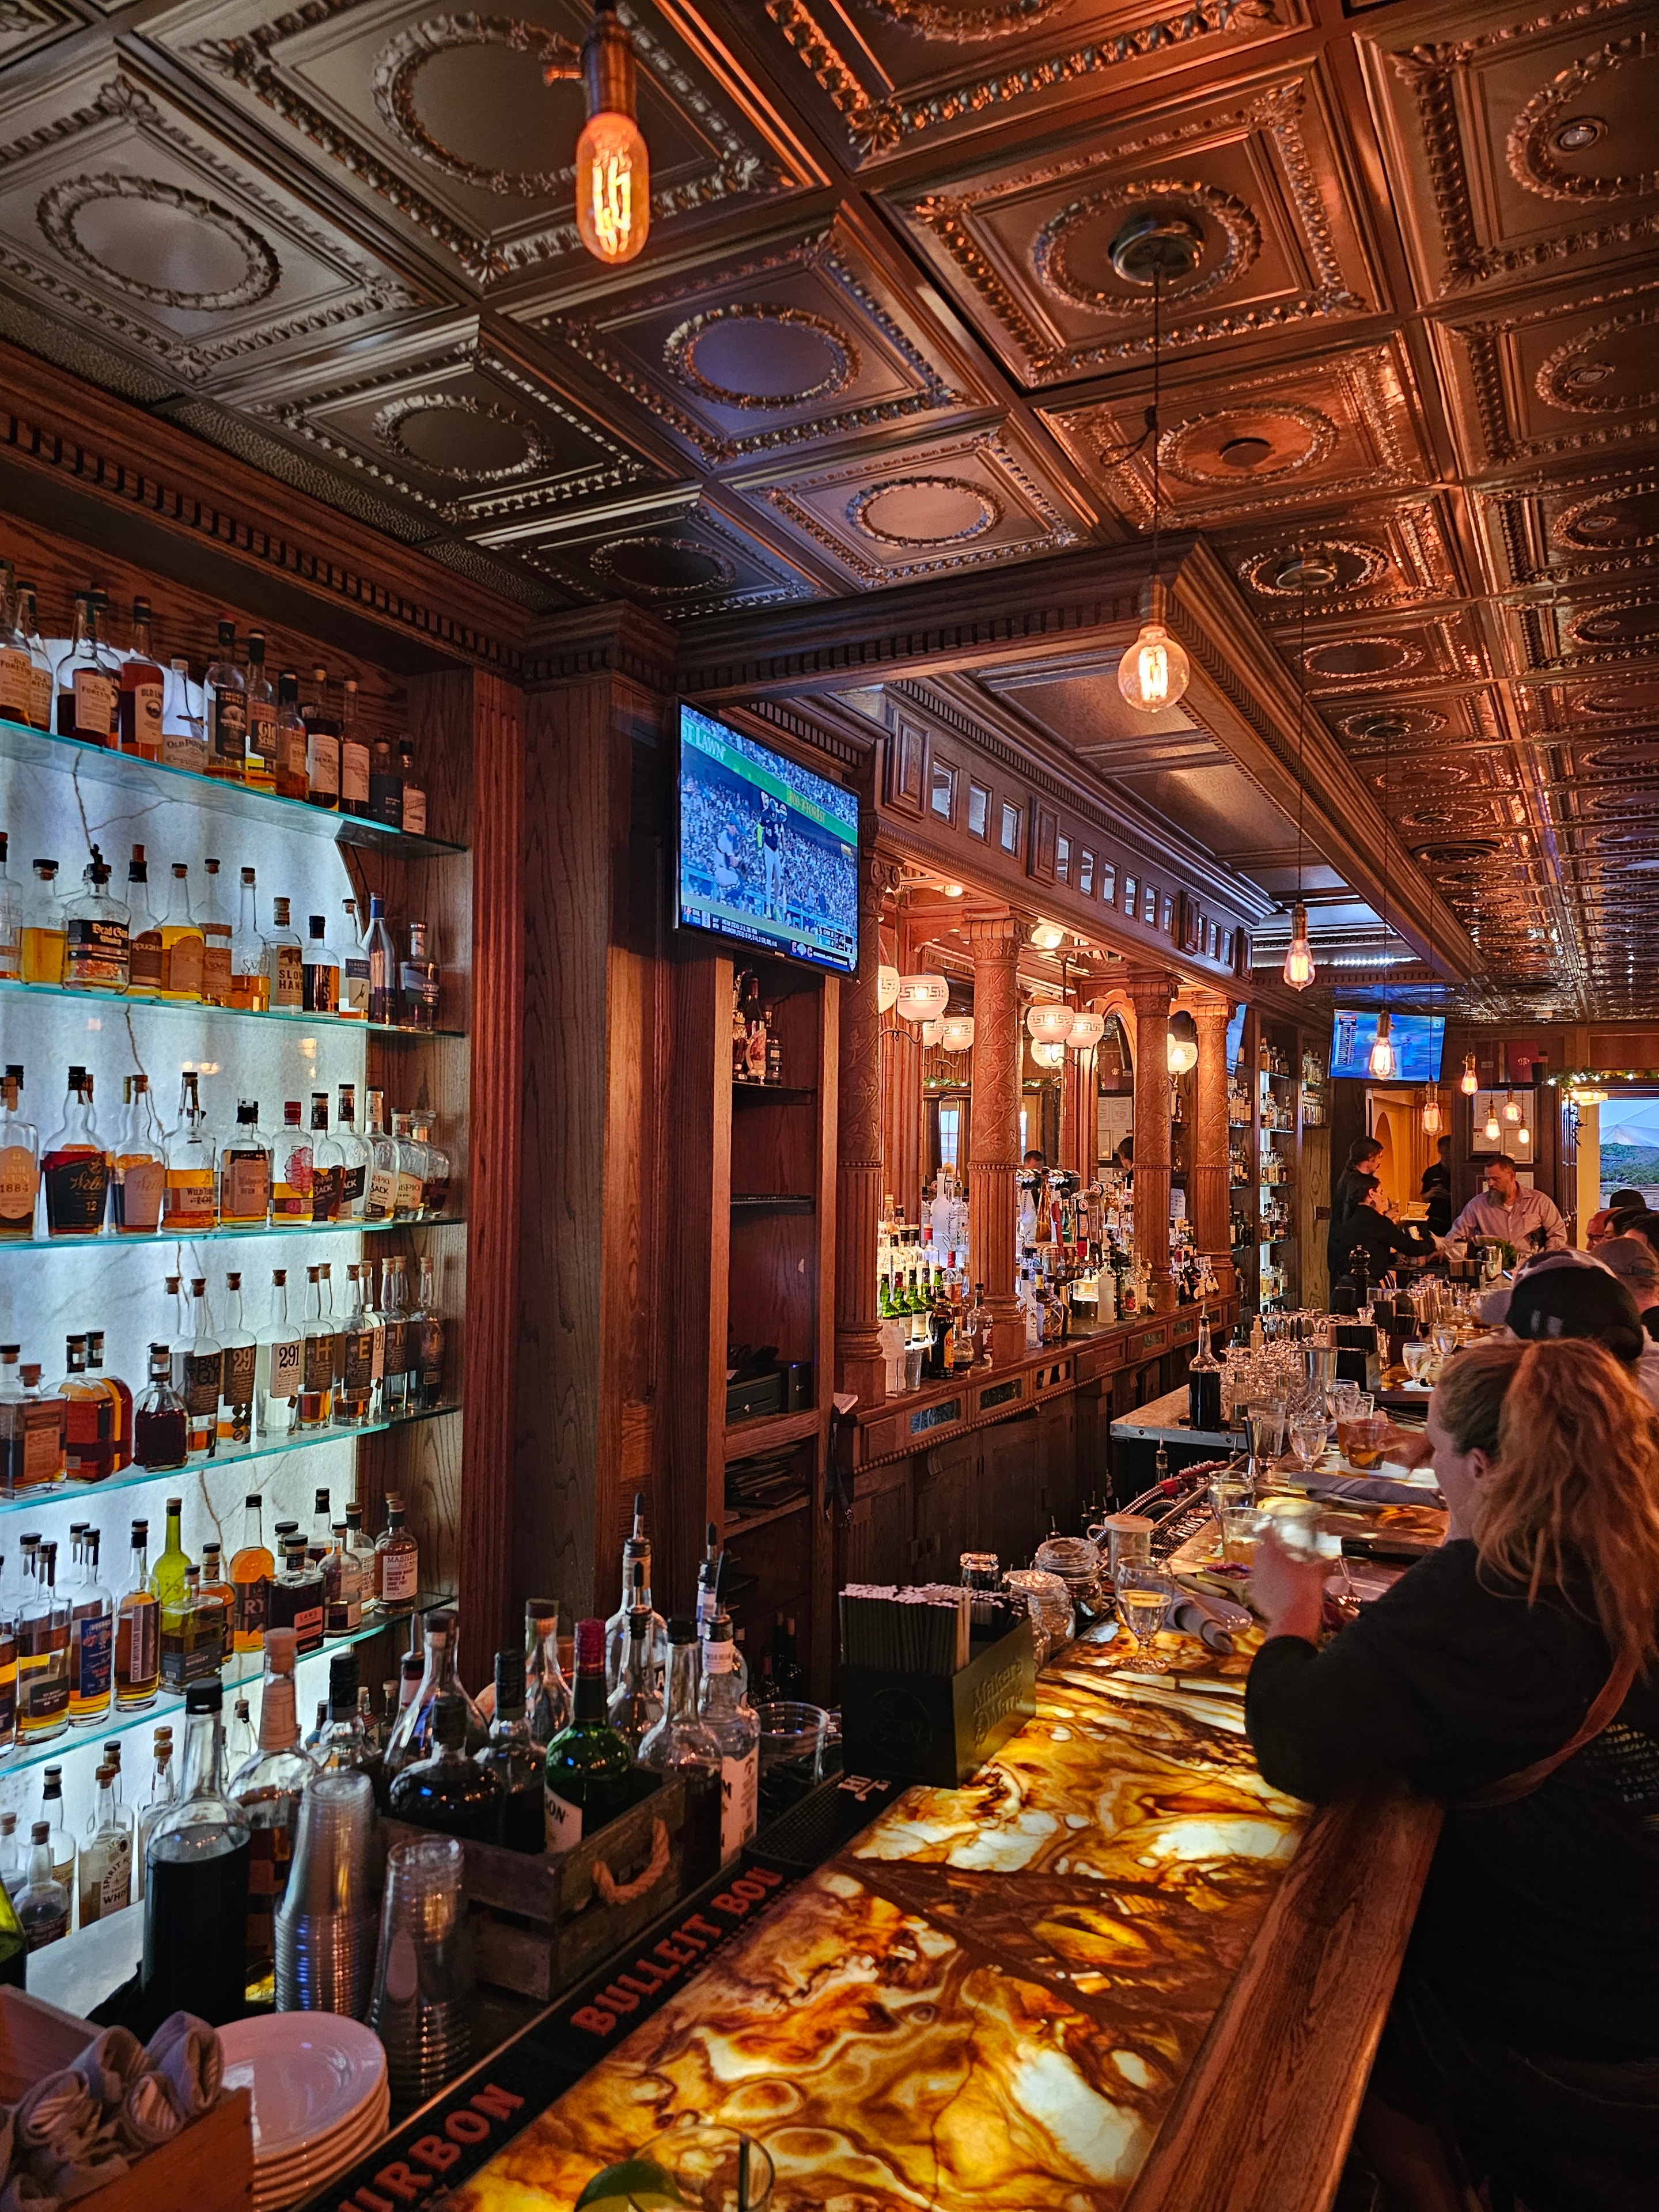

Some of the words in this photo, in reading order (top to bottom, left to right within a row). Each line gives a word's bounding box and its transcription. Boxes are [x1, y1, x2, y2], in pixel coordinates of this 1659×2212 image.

[166, 740, 184, 749] OLD
[92, 923, 112, 935] Dead
[369, 1106, 374, 1114] 6
[0, 1183, 29, 1193] 1884
[187, 1188, 203, 1196] WILD
[86, 1200, 98, 1211] 12
[279, 1344, 300, 1369] 291
[359, 1336, 370, 1359] E
[133, 1605, 142, 1632] BOURBON
[132, 1632, 141, 1661] MOUNTAIN
[131, 1661, 141, 1681] ROCKY
[973, 1658, 1021, 1710] Maker's
[103, 1863, 120, 1890] SPIRIT
[570, 1913, 722, 2037] BULLEIT
